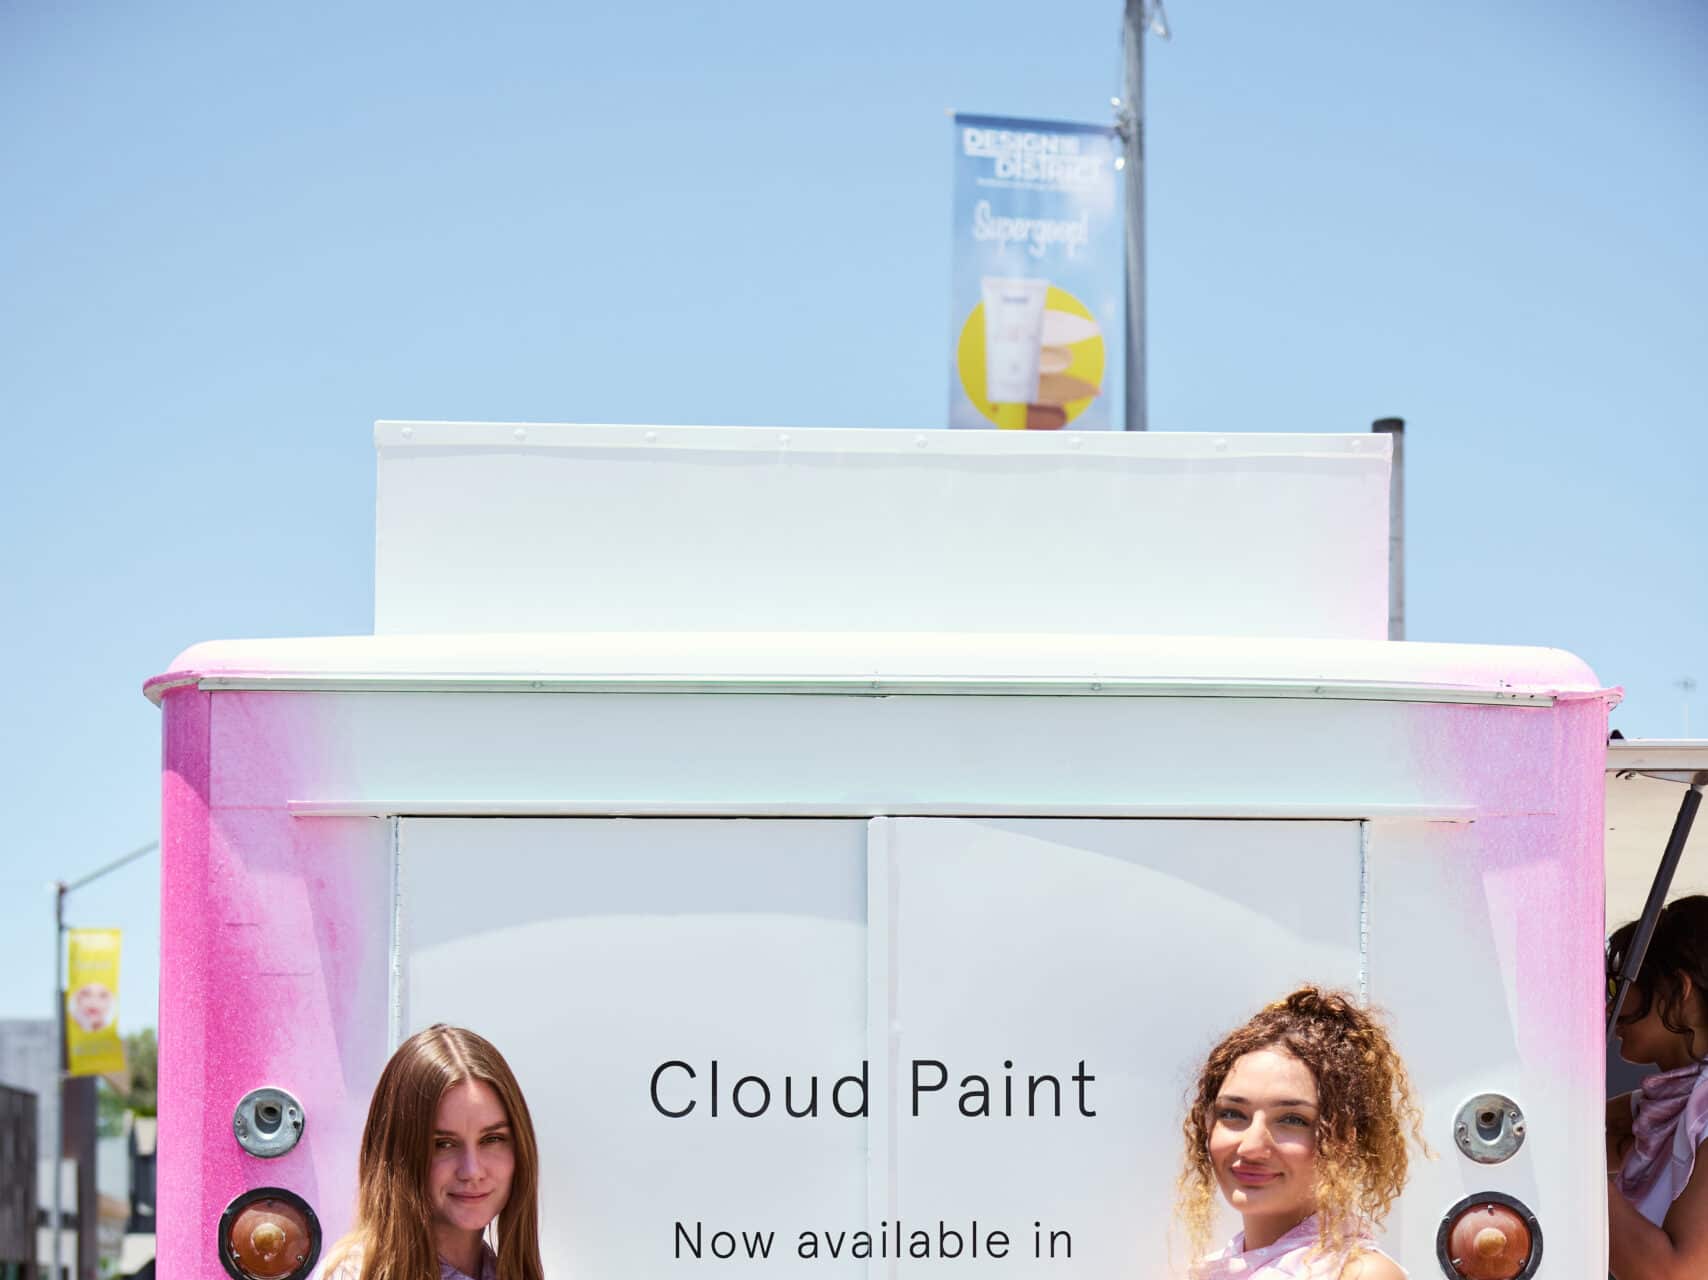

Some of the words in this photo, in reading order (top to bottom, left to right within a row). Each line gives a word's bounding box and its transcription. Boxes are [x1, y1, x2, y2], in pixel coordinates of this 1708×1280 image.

[650, 1060, 869, 1118] Cloud
[912, 1059, 1097, 1118] Paint
[674, 1221, 775, 1259] Now
[797, 1220, 1010, 1259] available
[1034, 1221, 1073, 1259] in
